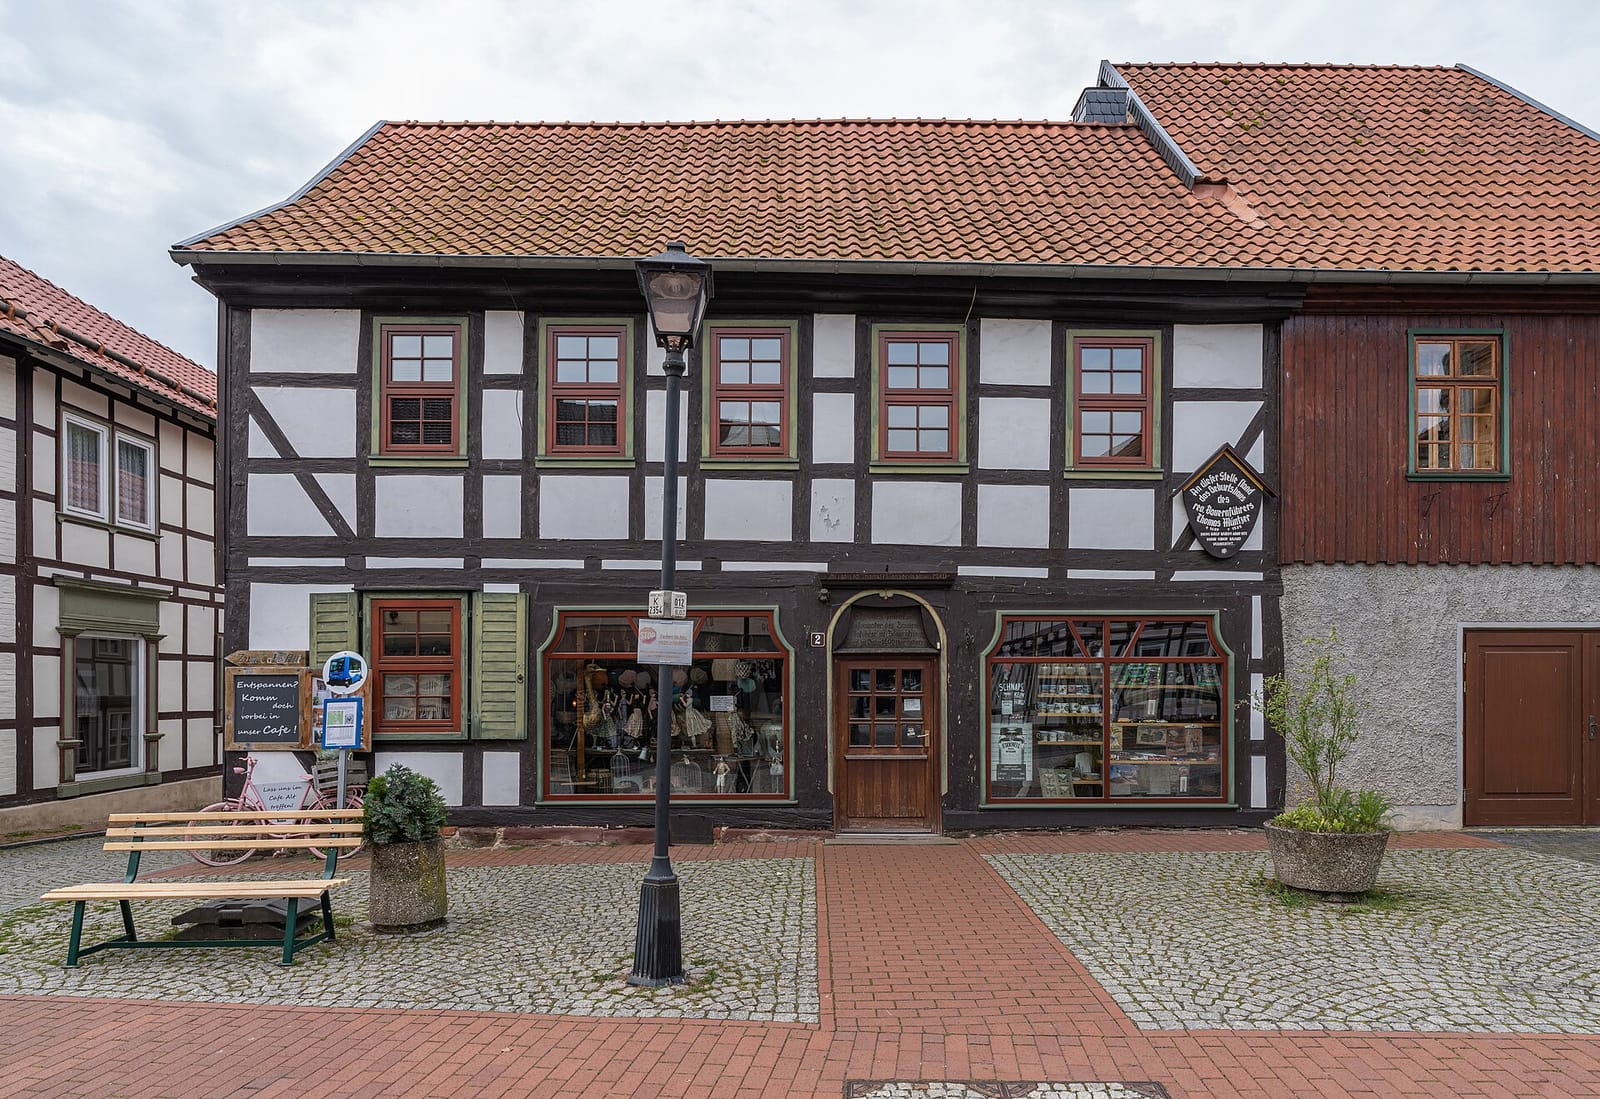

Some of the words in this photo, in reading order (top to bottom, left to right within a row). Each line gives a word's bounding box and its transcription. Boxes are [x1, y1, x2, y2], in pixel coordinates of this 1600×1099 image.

[1189, 487, 1202, 497] An
[1219, 472, 1238, 484] Stelle
[1198, 492, 1211, 503] das
[1218, 495, 1229, 503] des
[1197, 513, 1221, 527] Thomas
[1223, 515, 1250, 527] Müntzer
[650, 606, 662, 614] 2354
[640, 631, 656, 640] STOP
[815, 636, 821, 645] 2
[236, 680, 298, 690] Entspannen?
[998, 682, 1025, 692] SCHNAPS
[242, 694, 278, 702] Komm
[240, 712, 268, 720] vorbei
[238, 728, 262, 736] unser
